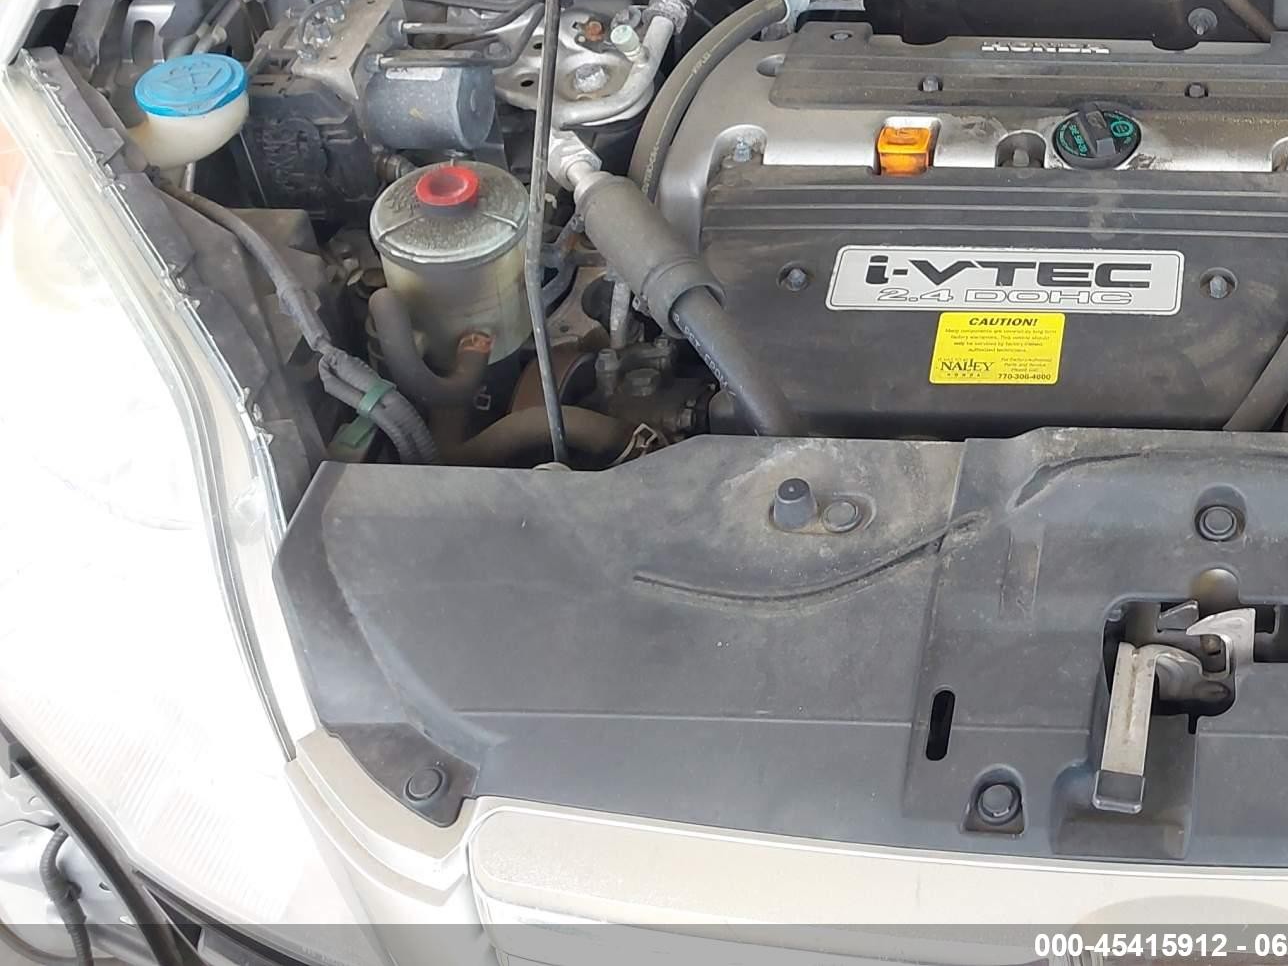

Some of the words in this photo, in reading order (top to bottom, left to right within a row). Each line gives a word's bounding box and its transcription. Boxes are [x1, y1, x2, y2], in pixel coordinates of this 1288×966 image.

[865, 254, 1153, 289] i-VTEC
[876, 287, 956, 303] 2.4
[964, 289, 1134, 305] DOHC
[968, 317, 1038, 326] CAUTION!
[940, 358, 996, 372] NALLEY
